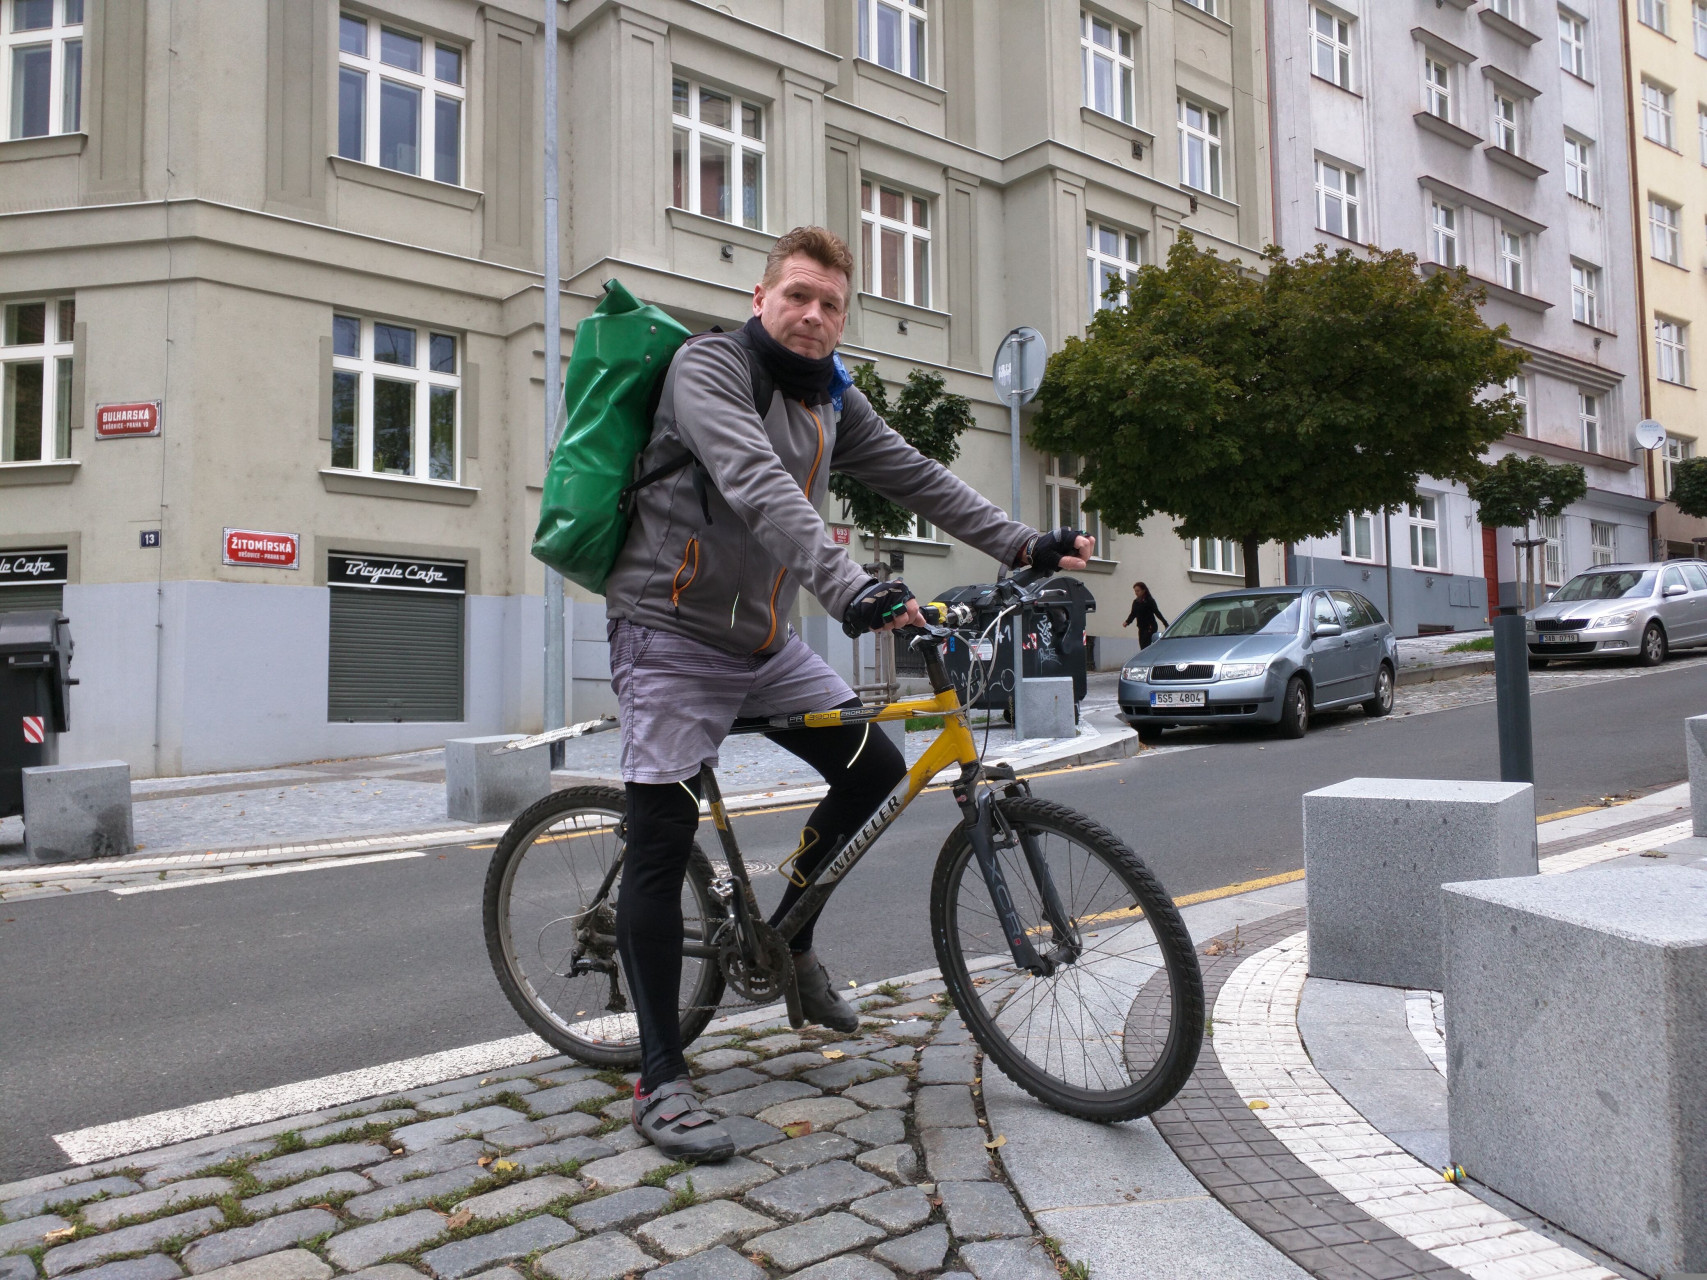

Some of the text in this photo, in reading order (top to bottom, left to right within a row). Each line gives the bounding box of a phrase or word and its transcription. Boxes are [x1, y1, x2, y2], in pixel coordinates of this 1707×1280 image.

[102, 408, 149, 422] BULHARSKÁ
[145, 534, 155, 545] 13
[231, 536, 292, 554] ŽITOMÍRSKÁ
[13, 557, 55, 576] Cafe
[345, 560, 448, 584] Bicycle Cafe
[1157, 693, 1201, 703] 5S5 4804
[829, 795, 901, 877] WHEELER
[985, 857, 1021, 936] XCR
